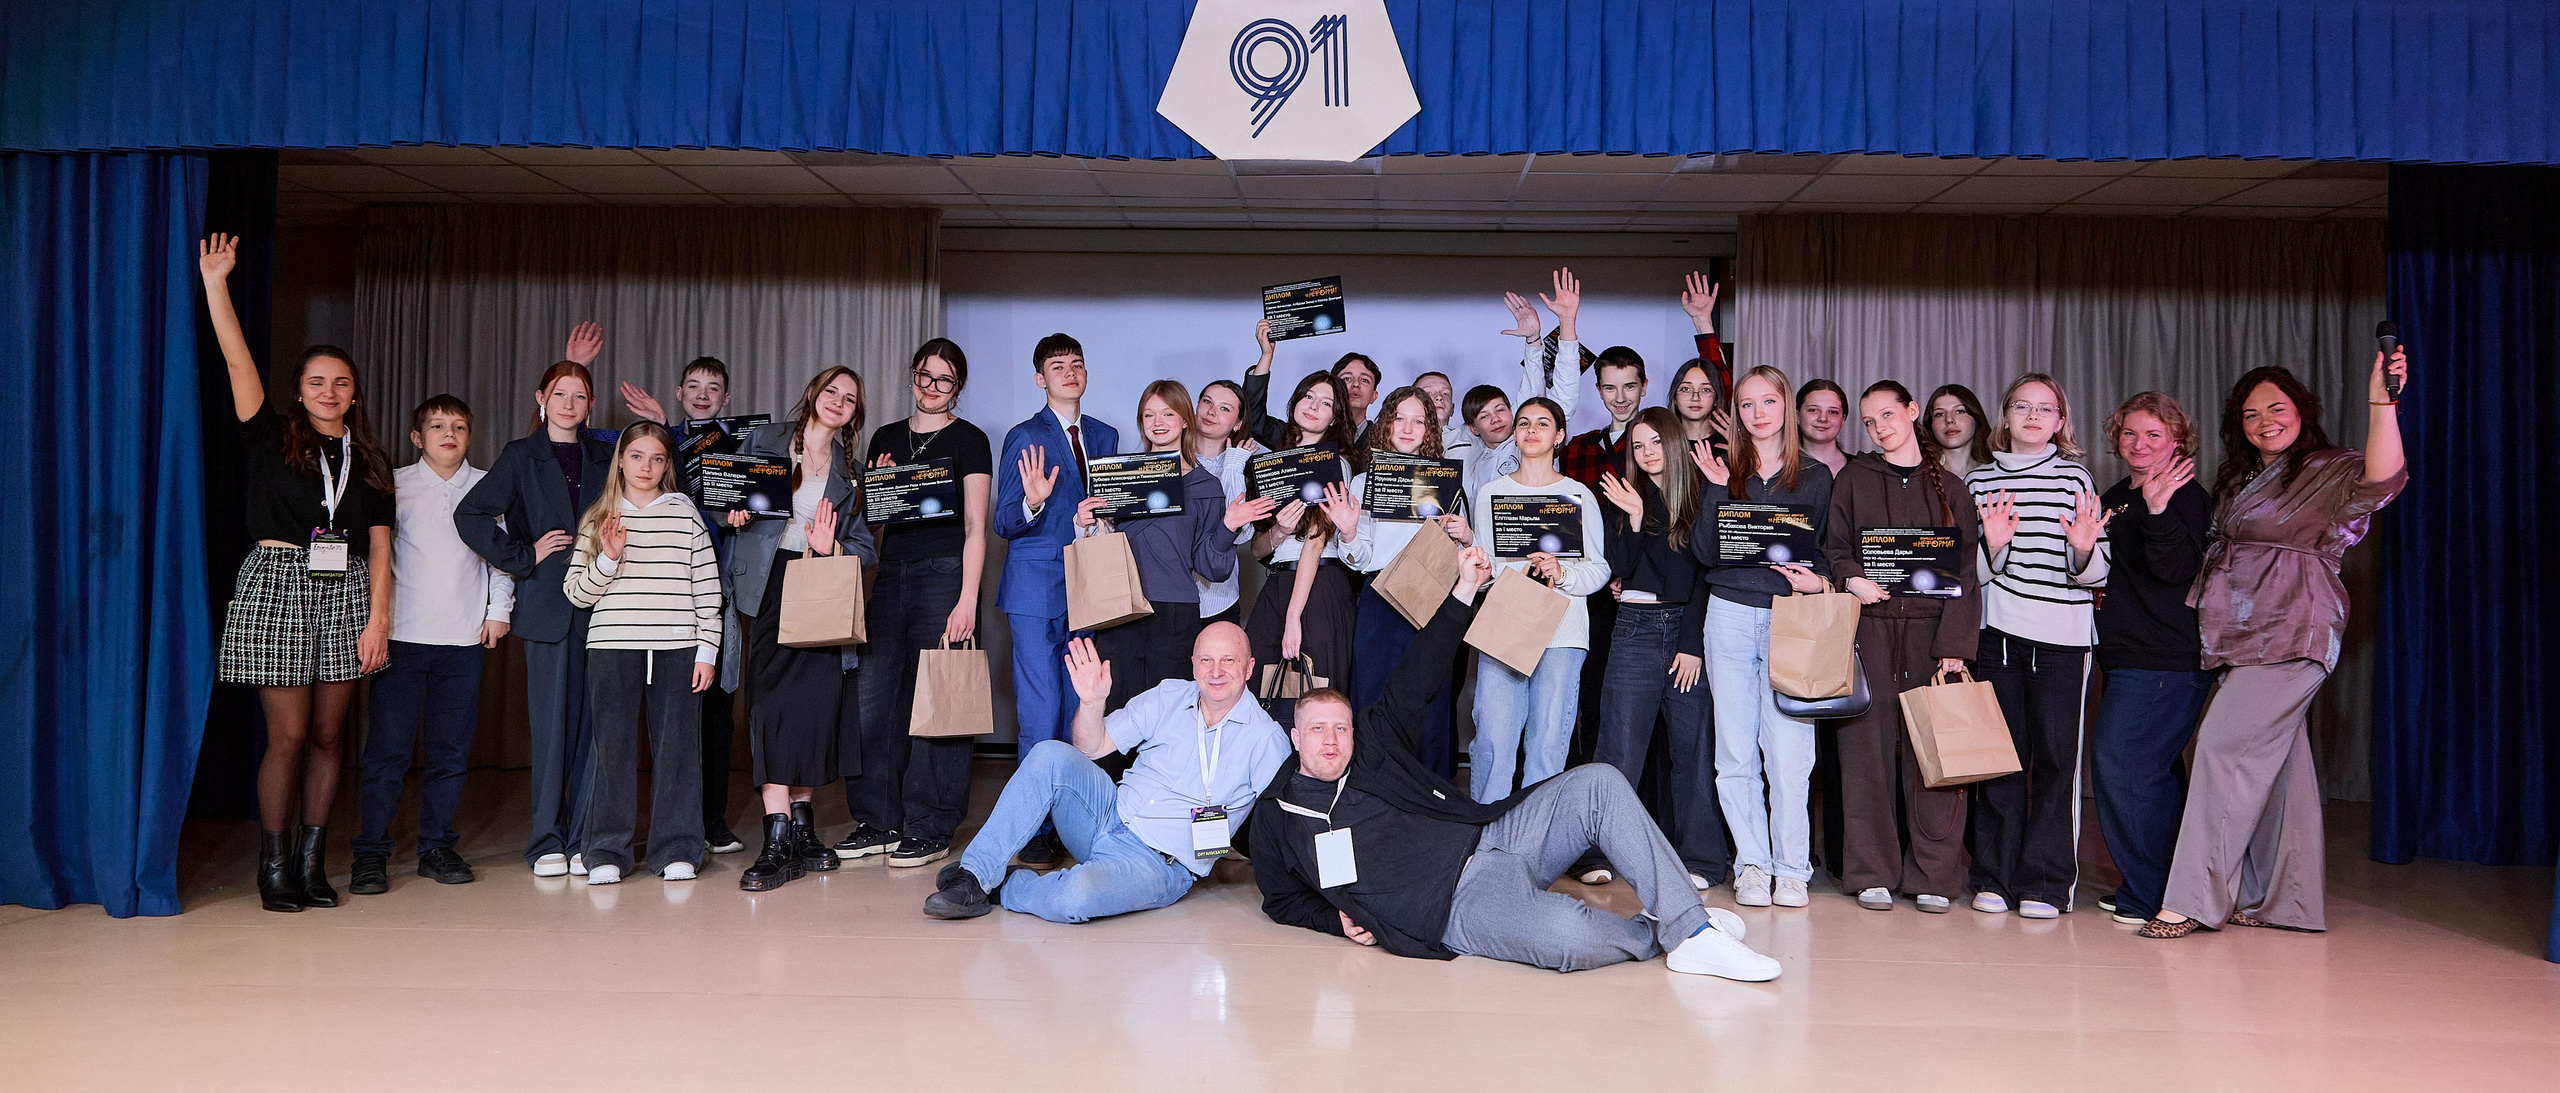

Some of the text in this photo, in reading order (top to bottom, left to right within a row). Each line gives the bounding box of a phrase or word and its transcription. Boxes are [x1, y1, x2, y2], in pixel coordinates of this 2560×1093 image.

[1229, 14, 1349, 138] 91
[1265, 291, 1291, 301] ДИПЛОМ
[702, 459, 732, 467] ДИПЛОМ
[1254, 458, 1283, 470] ДИПЛОМ
[1092, 464, 1122, 472] ДИПЛОМ
[865, 474, 895, 483] ДИПЛОМ
